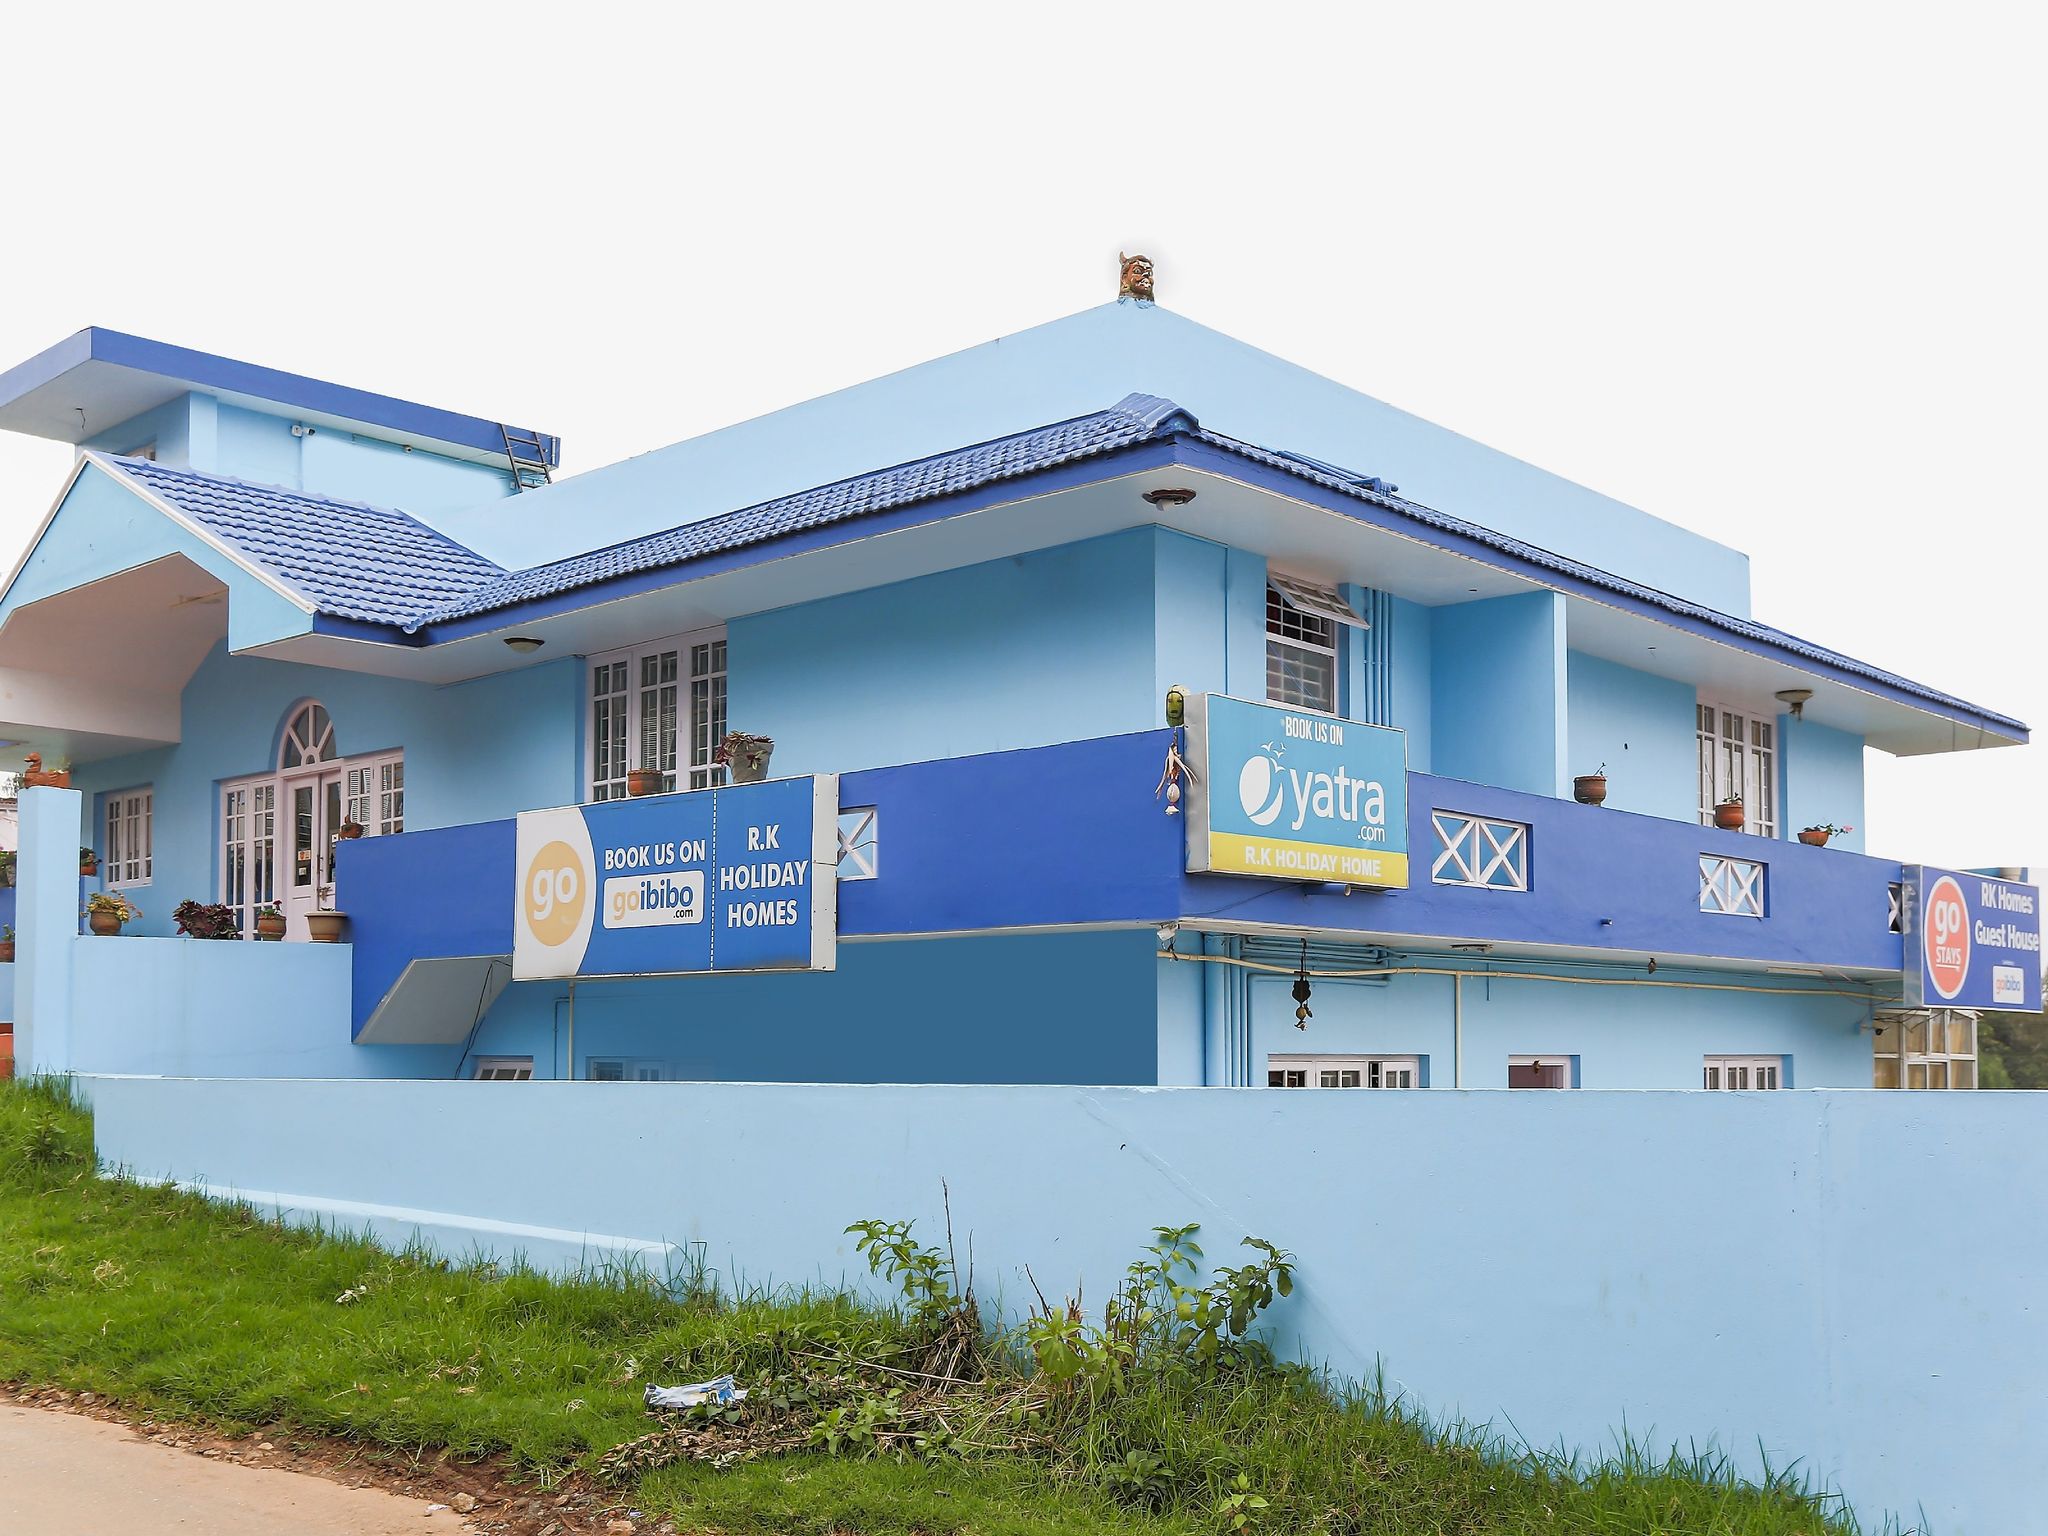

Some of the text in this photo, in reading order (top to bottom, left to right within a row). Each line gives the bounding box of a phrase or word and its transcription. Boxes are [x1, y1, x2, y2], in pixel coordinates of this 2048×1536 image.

[1285, 716, 1343, 745] BOOK US ON
[1289, 765, 1385, 831] yatra
[748, 824, 780, 851] R.K
[605, 839, 705, 870] BOOK US ON
[1245, 846, 1381, 877] R.K HOLIDAY HOME
[720, 860, 809, 891] HOLIDAY
[532, 866, 578, 920] go
[613, 879, 693, 920] goibibo
[1981, 882, 2034, 915] RK Homes
[727, 900, 798, 928] HOMES
[1934, 900, 1961, 944] go
[1975, 919, 2040, 952] Guest House
[1936, 946, 1961, 965] STAYS
